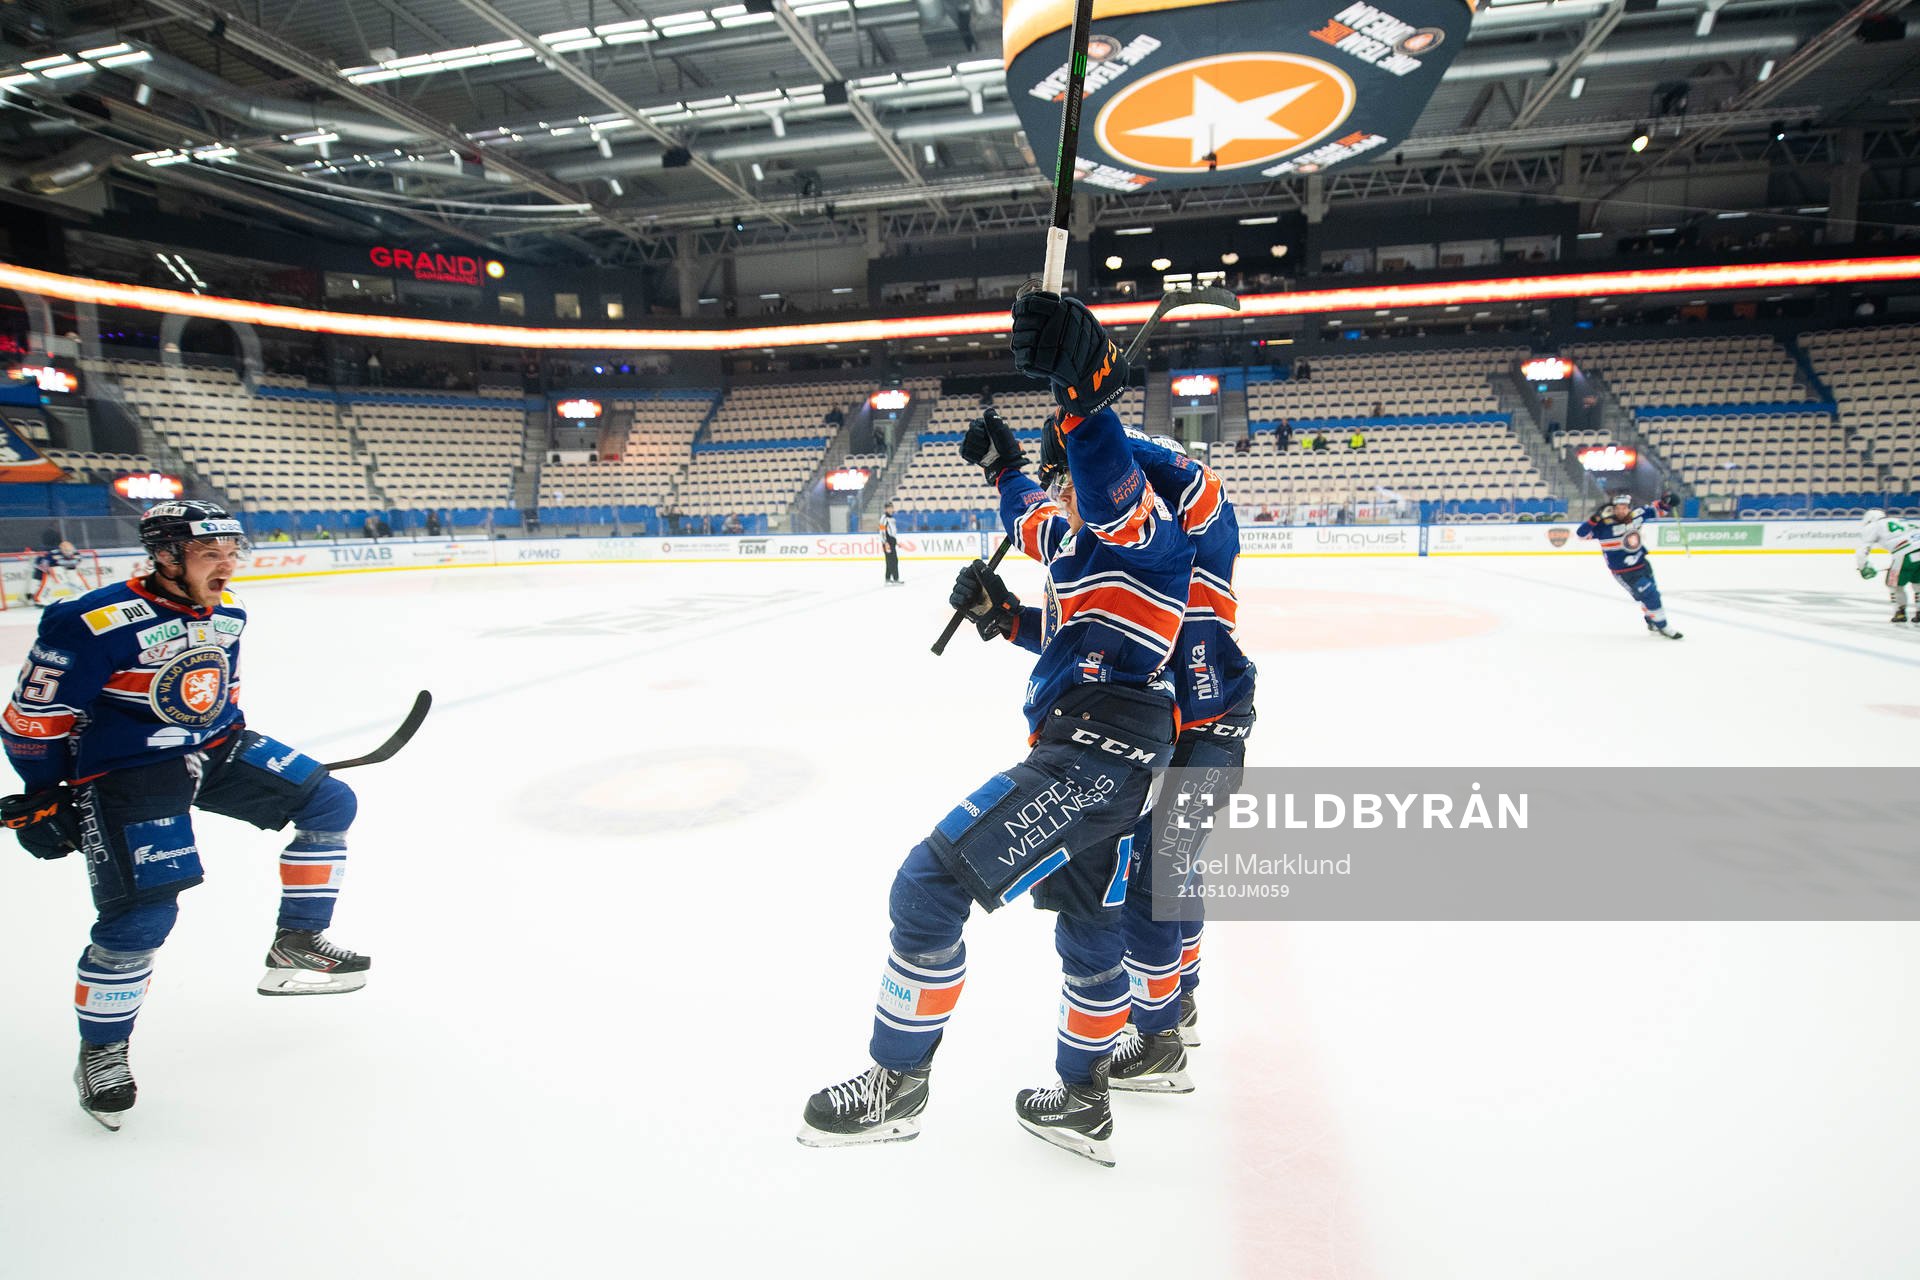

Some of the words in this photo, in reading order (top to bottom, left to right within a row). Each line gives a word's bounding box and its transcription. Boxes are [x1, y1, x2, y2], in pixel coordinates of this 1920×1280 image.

[370, 246, 477, 275] GRAND
[1091, 338, 1118, 392] CM
[921, 539, 963, 552] VISMA
[1240, 532, 1294, 541] YDTRADE
[329, 547, 393, 562] TIVAB
[518, 548, 560, 560] KPMG
[816, 538, 890, 556] Scandi
[244, 554, 306, 569] CM
[143, 622, 180, 646] wilo
[165, 706, 197, 723] STORT
[1071, 727, 1157, 765] CCM
[6, 802, 59, 830] CM
[959, 799, 982, 818] sons
[998, 774, 1115, 867] WELLNESS
[303, 953, 331, 967] CCM
[881, 974, 911, 1003] STENA
[1123, 1060, 1143, 1074] CCM
